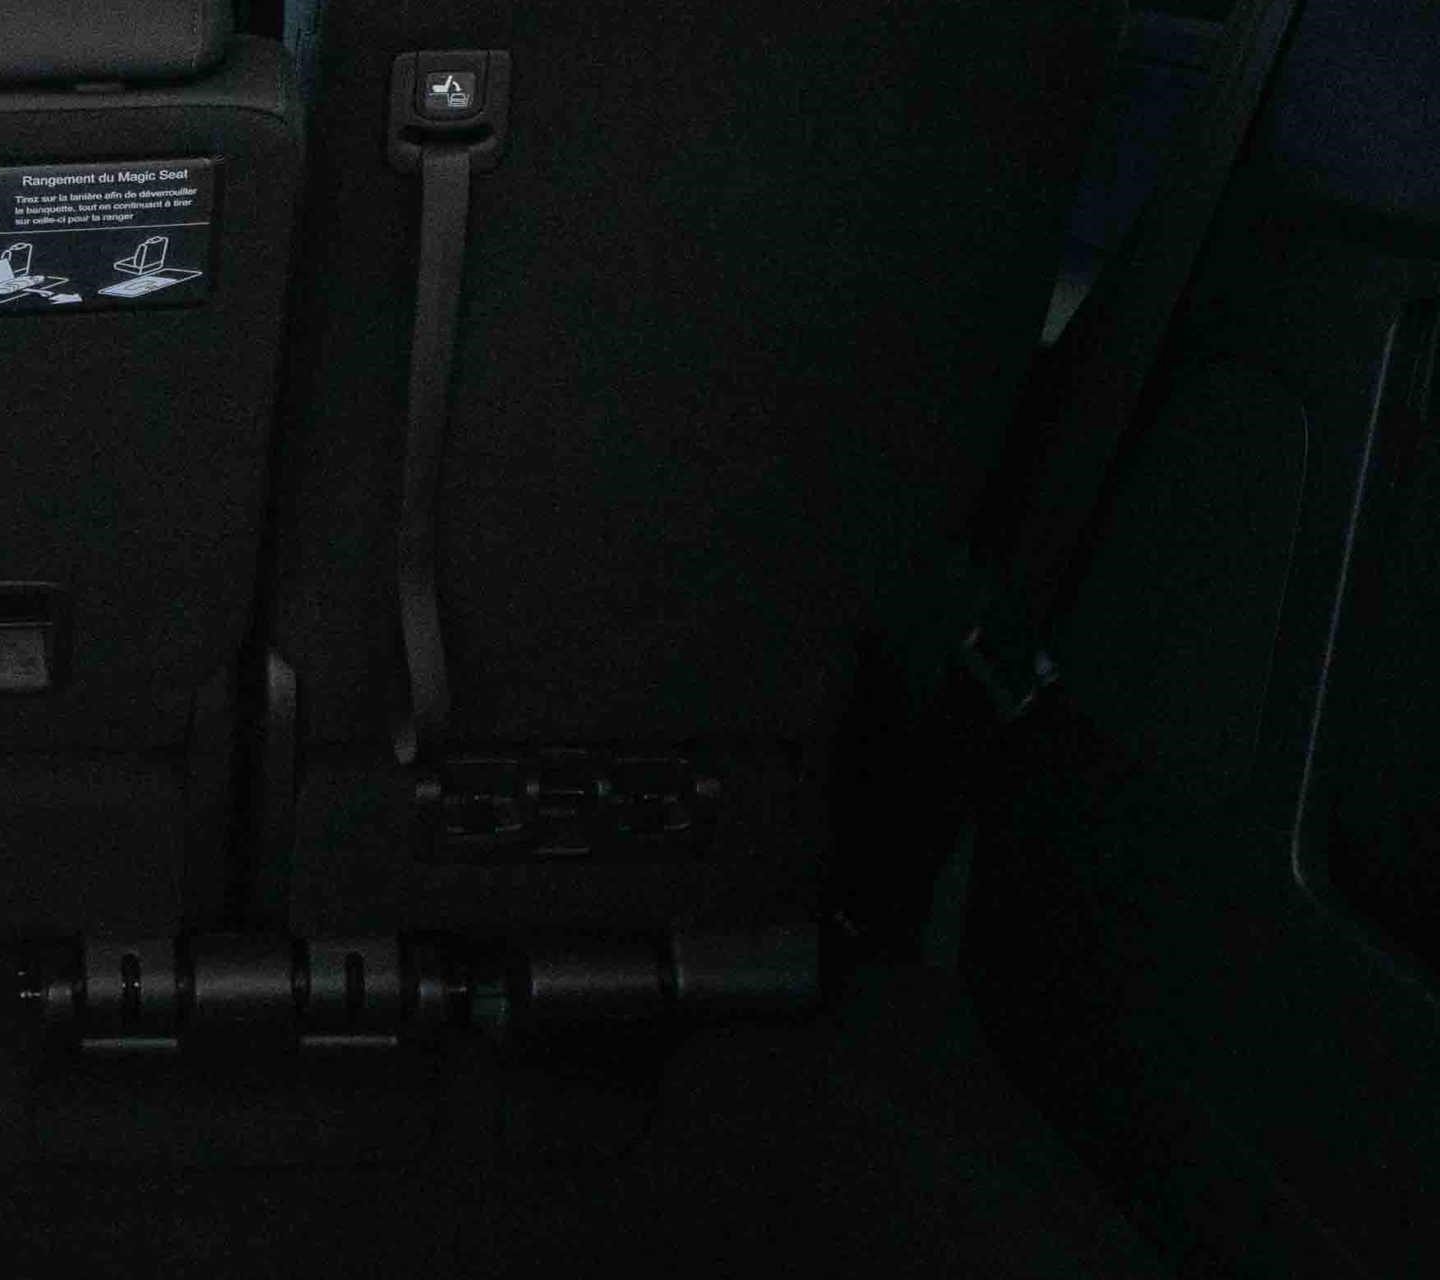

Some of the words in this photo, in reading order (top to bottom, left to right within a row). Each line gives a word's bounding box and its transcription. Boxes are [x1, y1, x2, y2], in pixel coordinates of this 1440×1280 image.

[22, 174, 95, 187] Rangement
[98, 172, 114, 183] du
[118, 171, 156, 183] Magic
[159, 169, 188, 180] Seat
[15, 195, 40, 204] Tirez
[41, 195, 57, 203] sur
[59, 194, 68, 202] la
[70, 192, 103, 201] lanière
[105, 190, 123, 200] afin
[125, 190, 137, 199] de
[113, 200, 162, 210] continuant
[68, 214, 89, 224] pour
[92, 213, 101, 221] la
[103, 212, 135, 222] ranger
